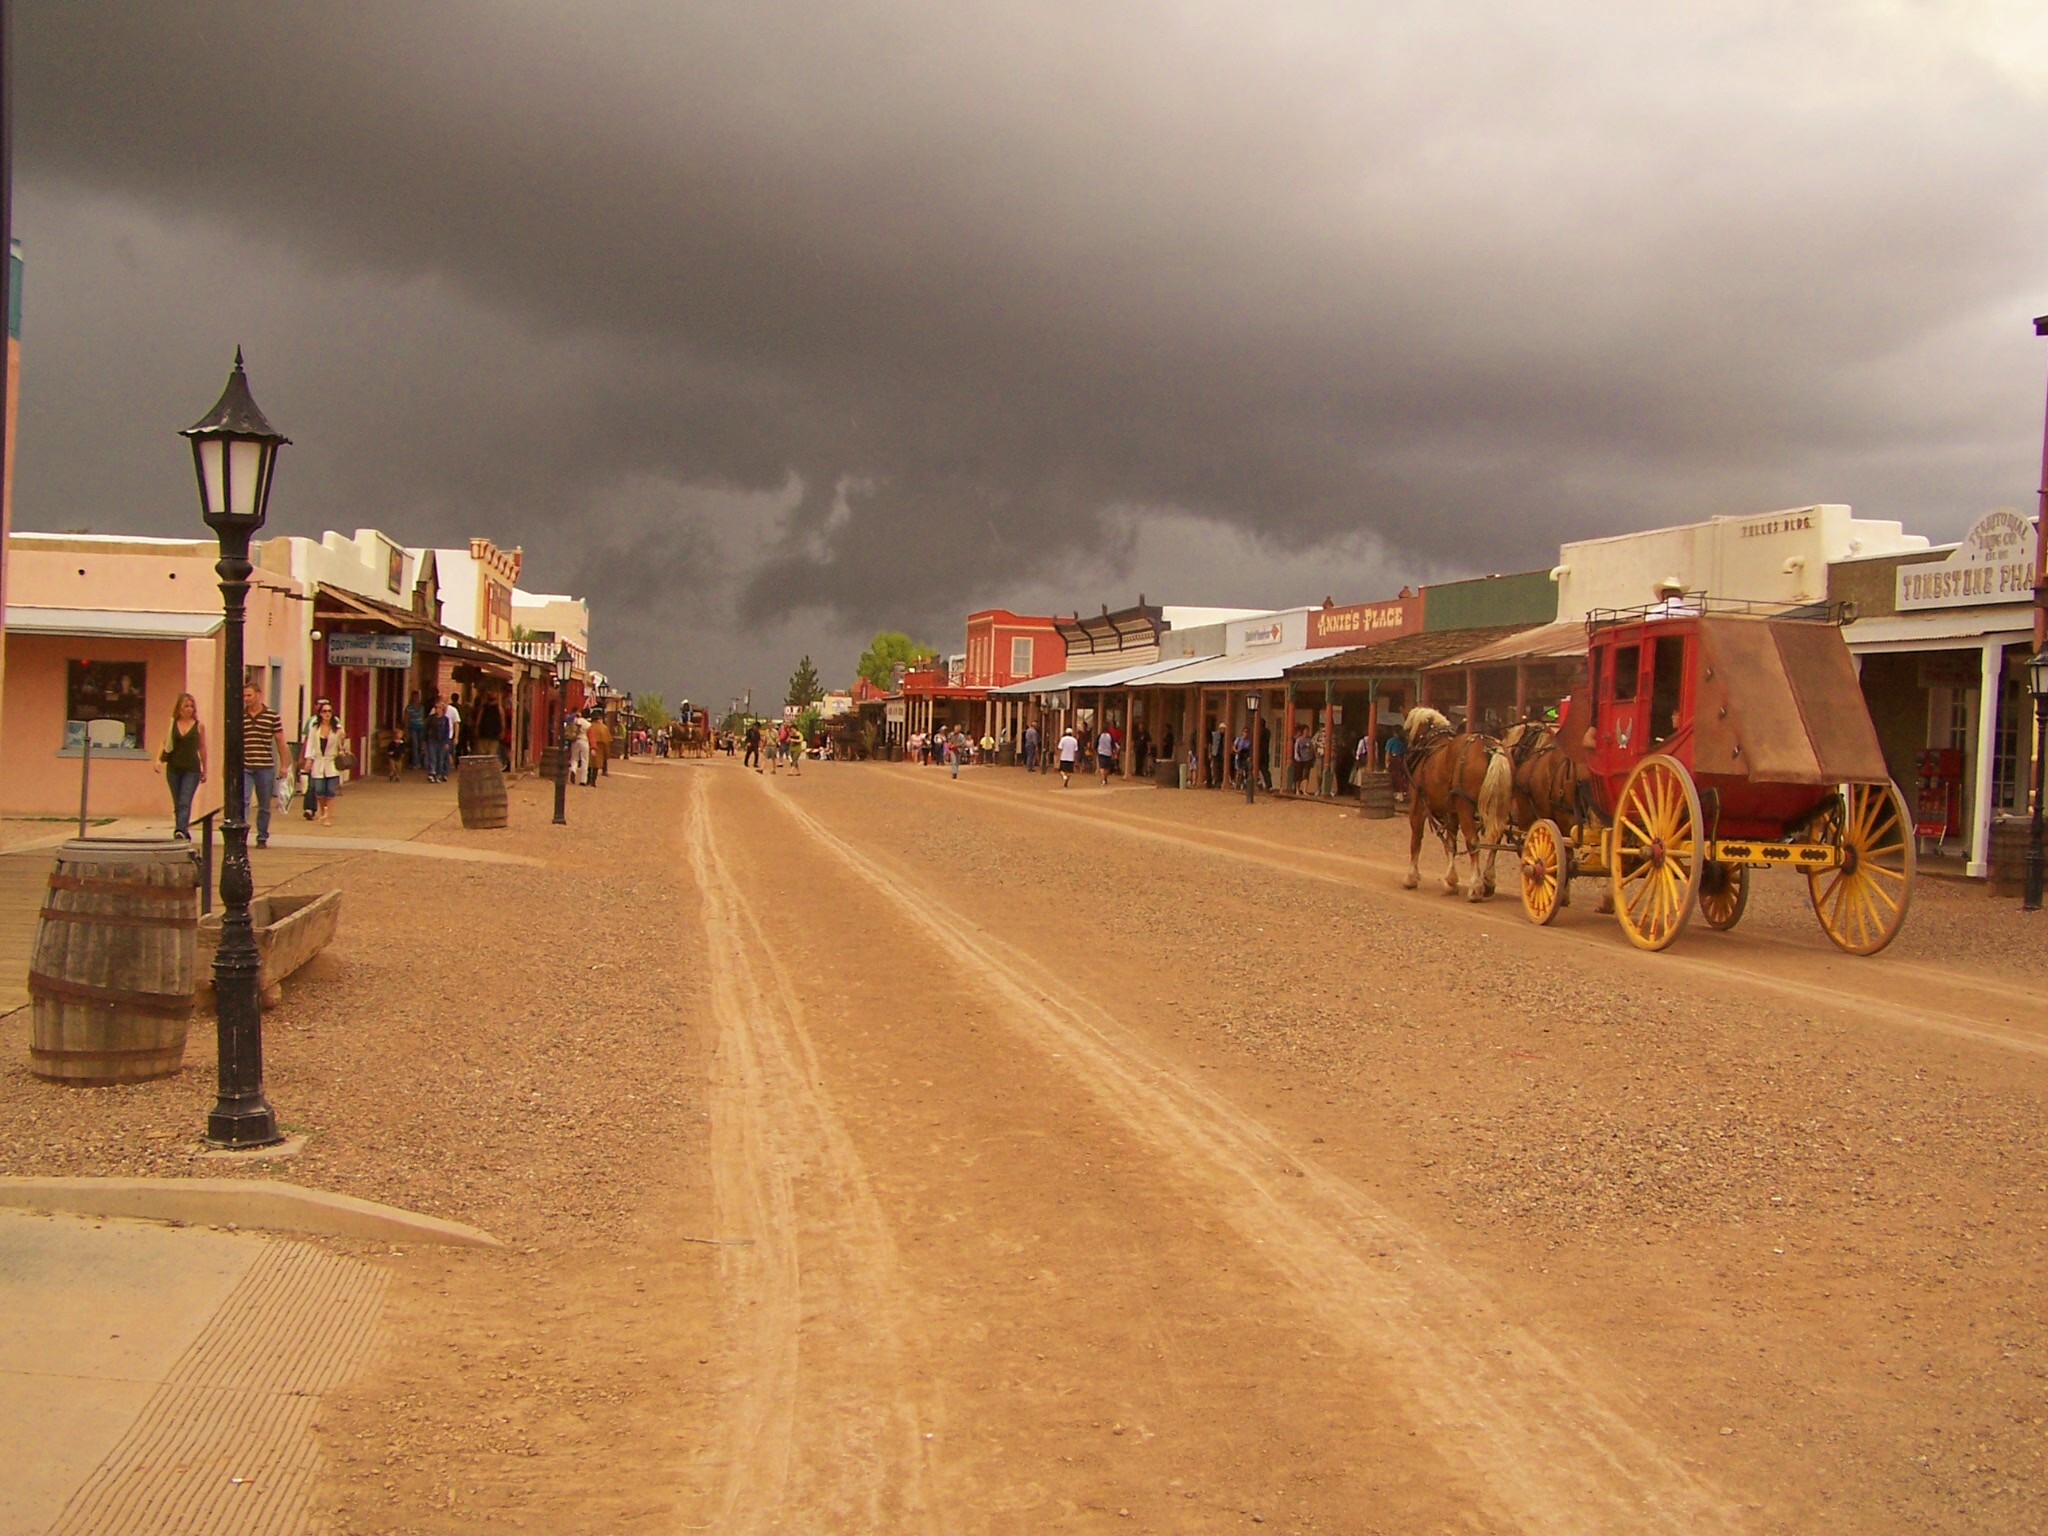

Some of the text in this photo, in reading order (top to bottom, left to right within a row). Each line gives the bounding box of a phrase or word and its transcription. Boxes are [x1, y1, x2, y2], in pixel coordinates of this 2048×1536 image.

[1903, 567, 1993, 600] TOMBSTONE
[1317, 607, 1403, 637] ANNIE'S PLACE
